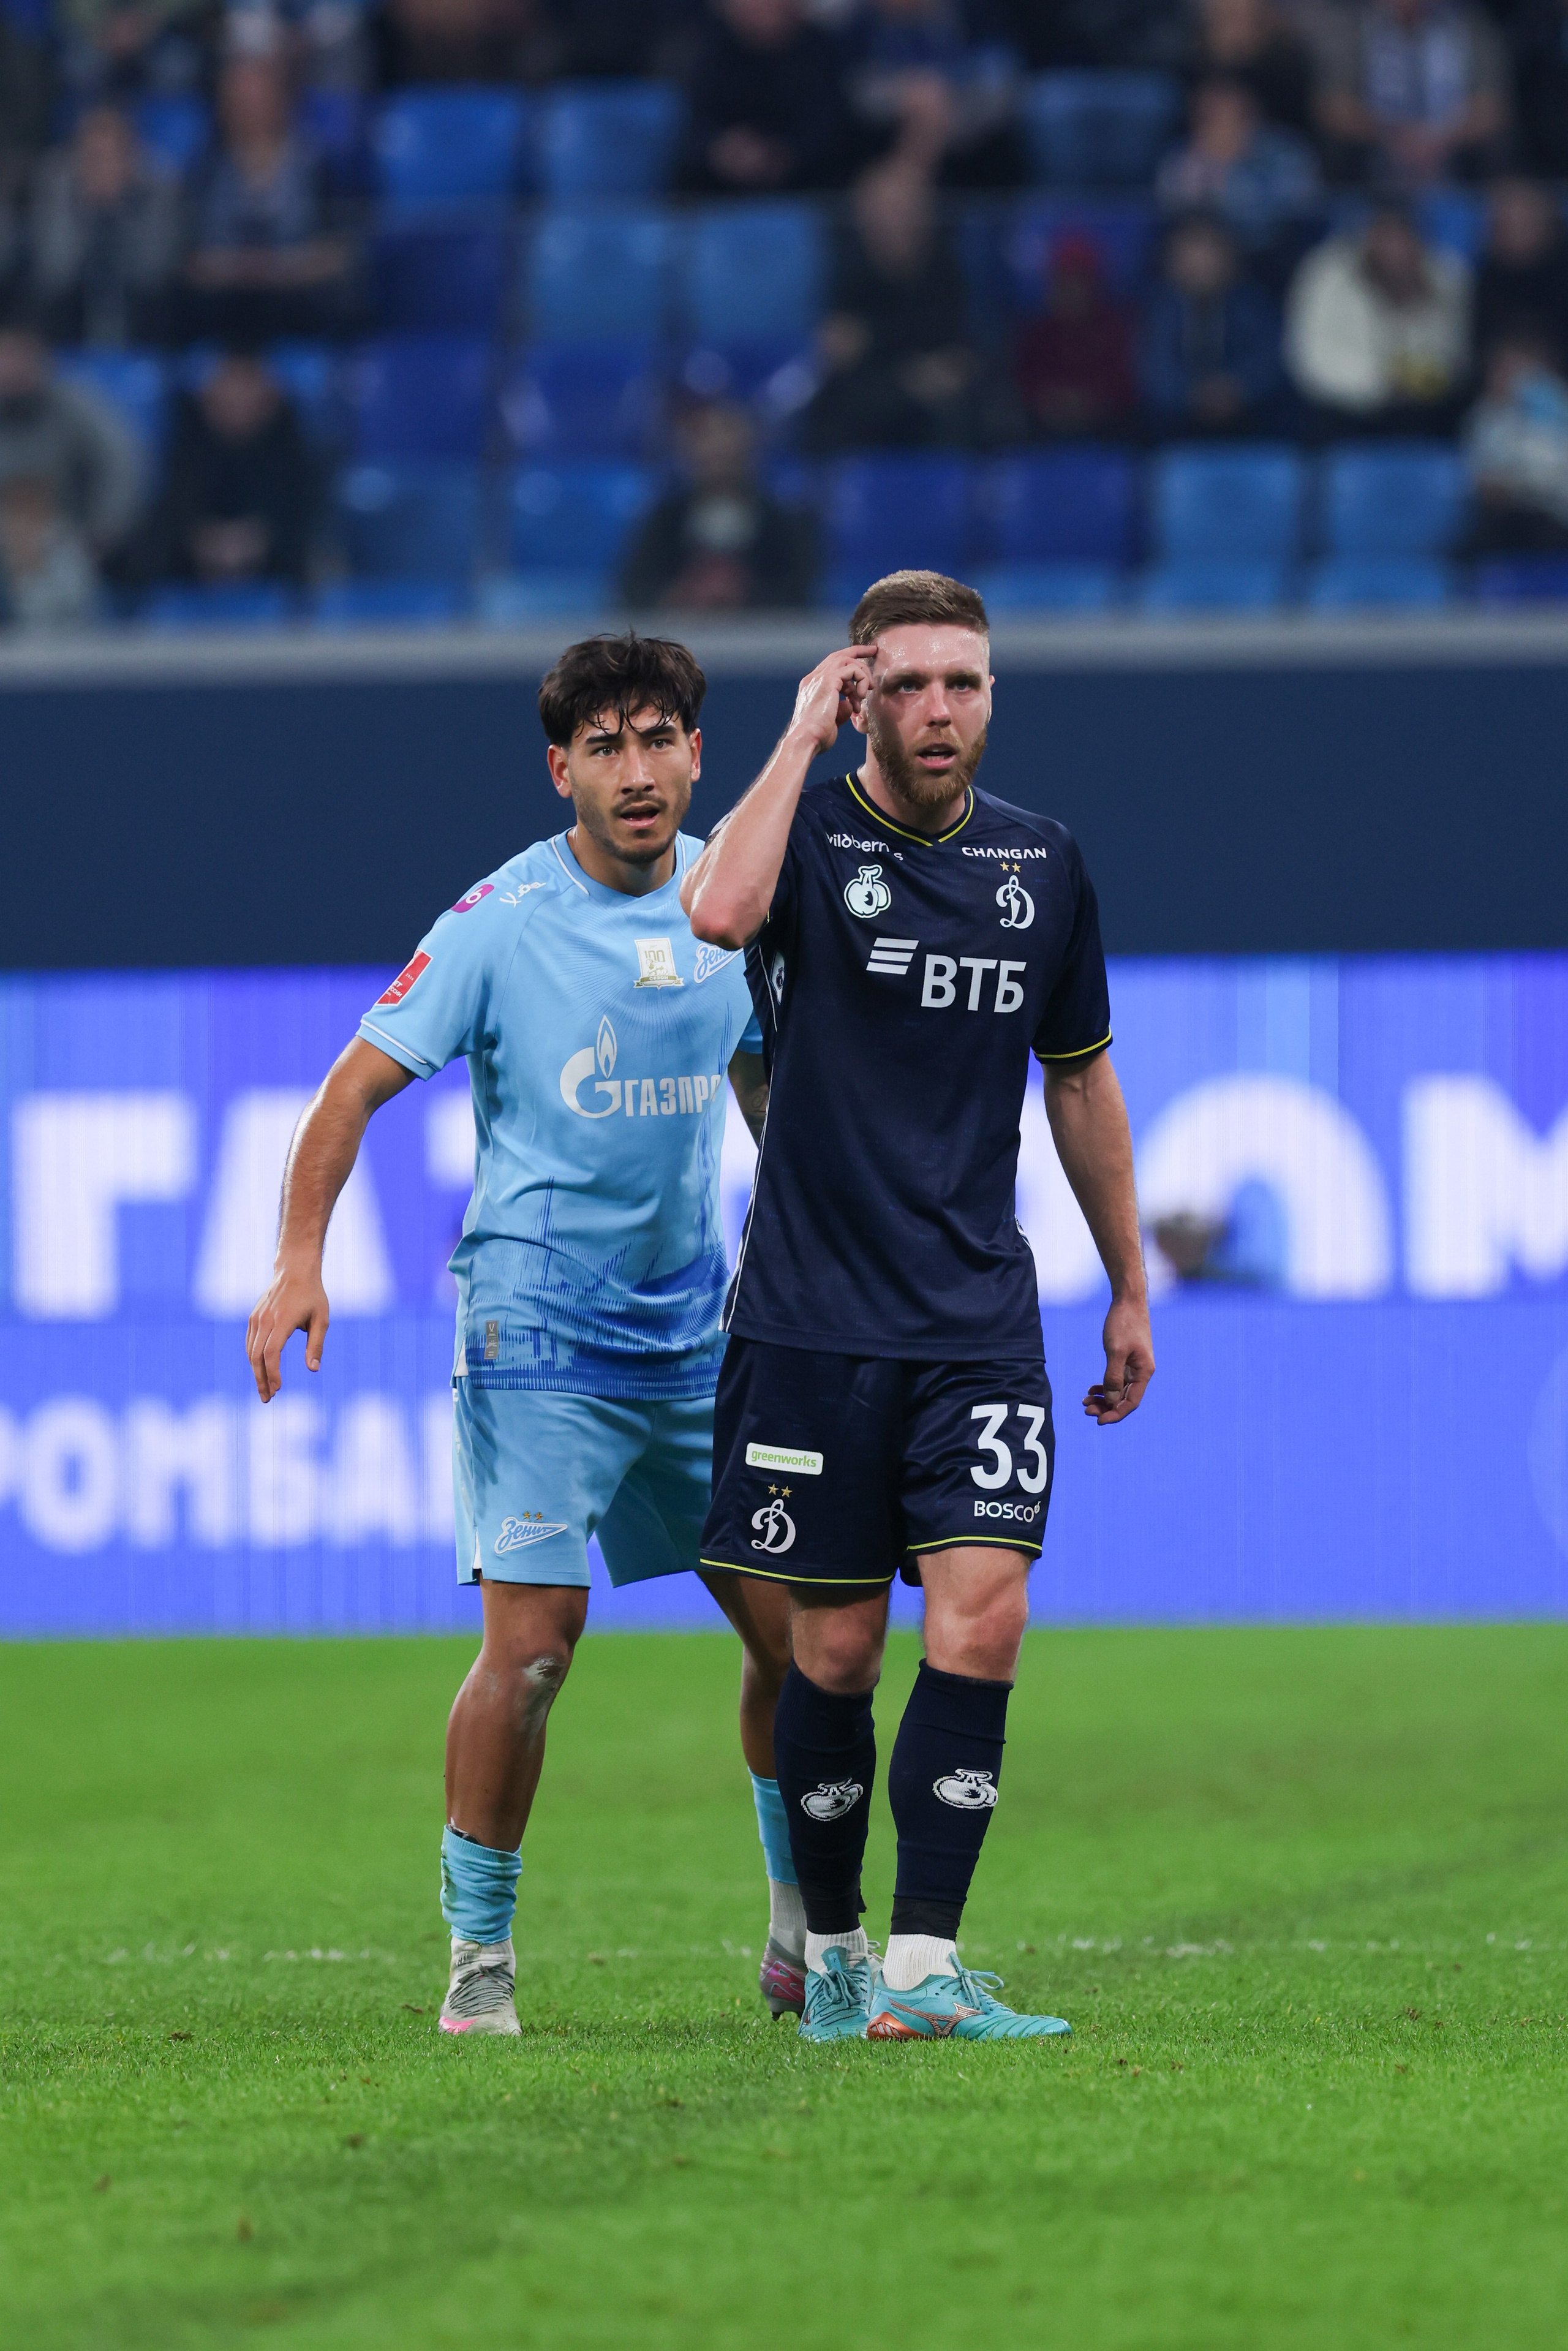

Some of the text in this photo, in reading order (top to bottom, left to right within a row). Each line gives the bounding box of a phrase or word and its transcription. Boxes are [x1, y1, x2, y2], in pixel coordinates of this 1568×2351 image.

[961, 847, 1047, 859] CHANGAN
[921, 954, 1027, 1013] ВТБ
[751, 1451, 817, 1468] greenworks
[970, 1403, 1047, 1494] 33
[974, 1500, 1035, 1523] BOSCO
